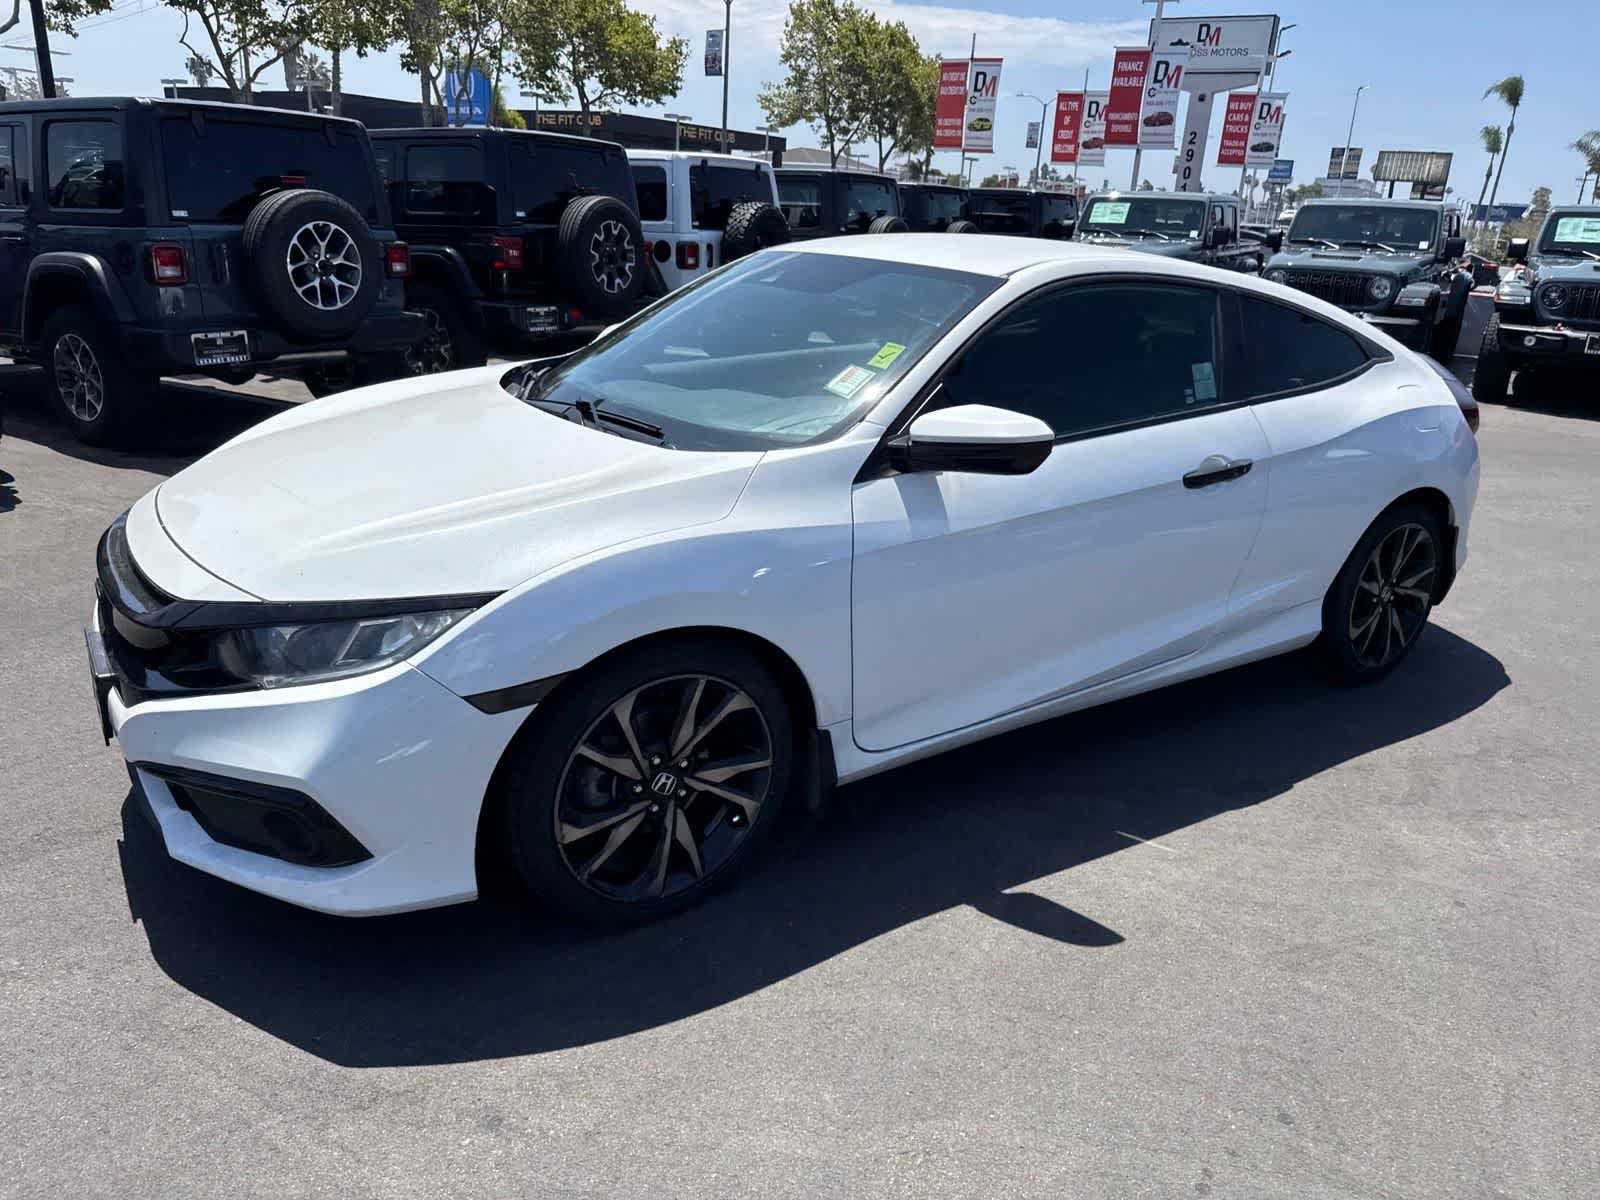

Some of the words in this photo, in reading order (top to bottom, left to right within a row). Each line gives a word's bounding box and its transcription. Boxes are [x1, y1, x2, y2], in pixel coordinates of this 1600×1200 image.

[1210, 48, 1249, 57] MOTORS
[1117, 61, 1144, 72] FINANCE
[1112, 76, 1144, 87] AVAILABLE
[537, 114, 556, 125] THE
[558, 115, 573, 125] FIT
[576, 115, 601, 127] CUB
[1226, 125, 1248, 133] TRUCKS
